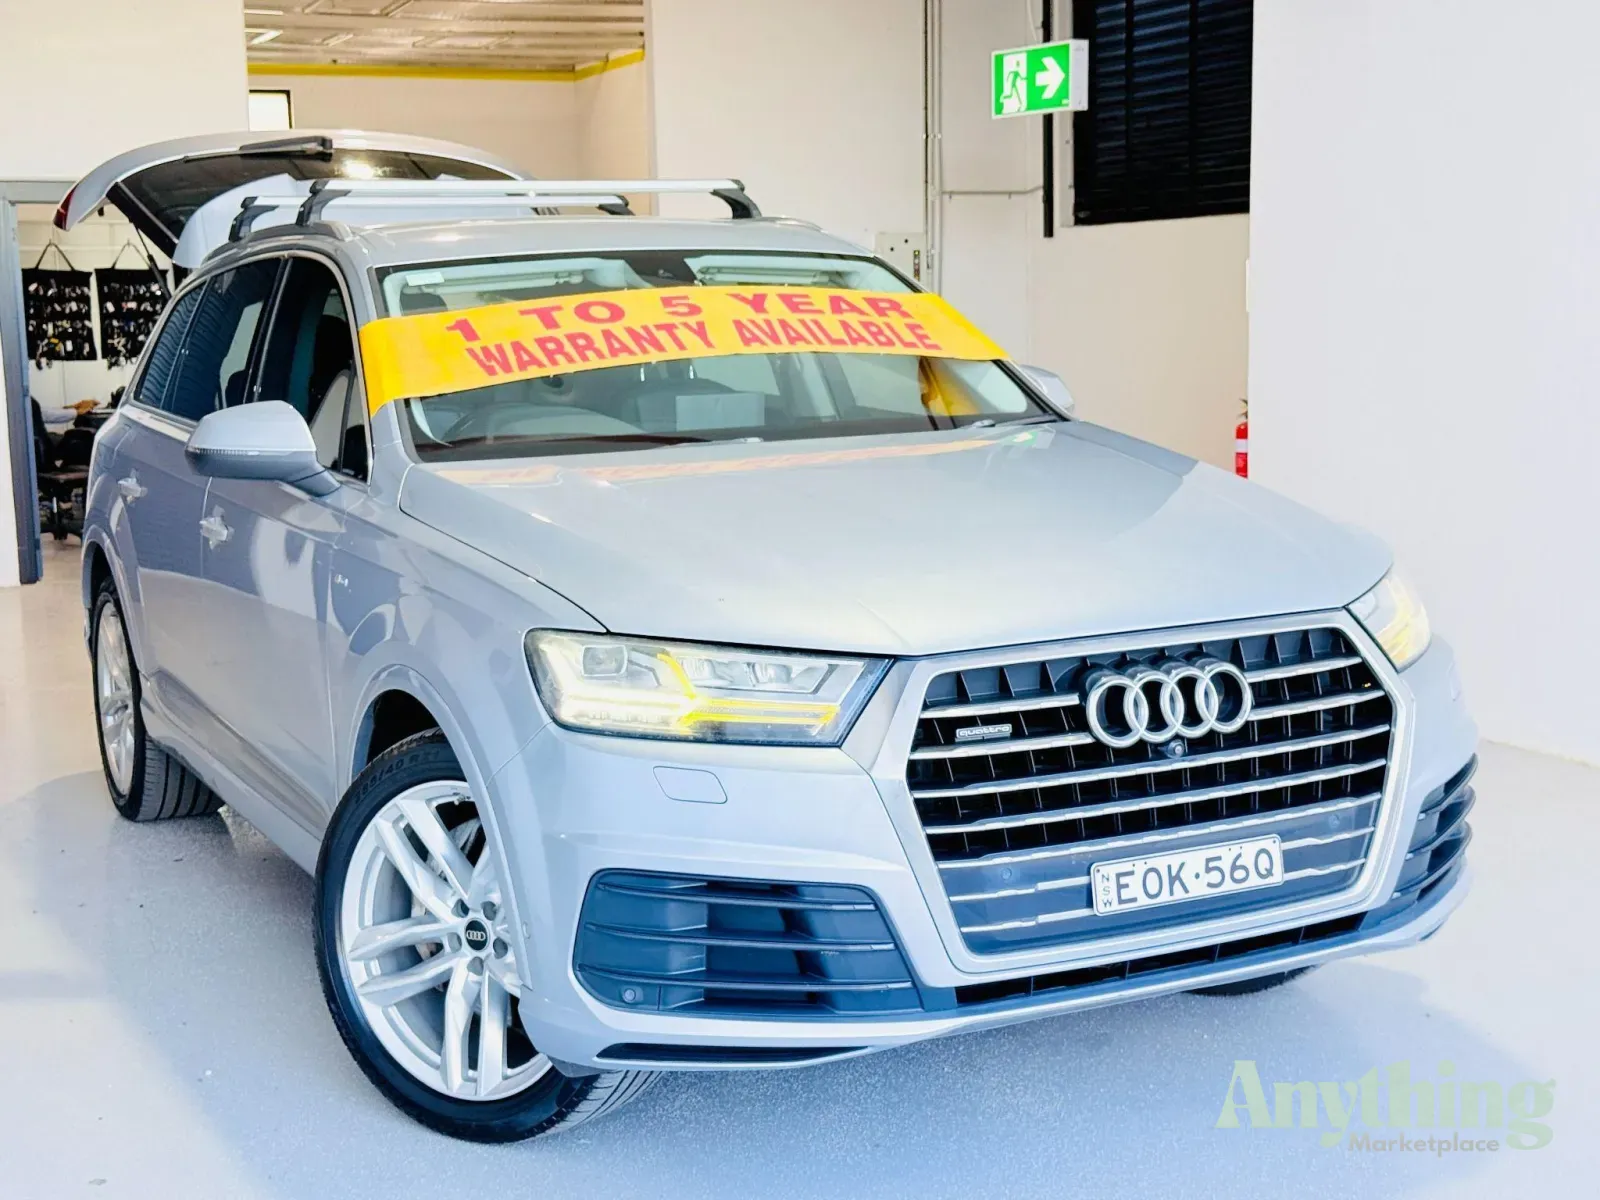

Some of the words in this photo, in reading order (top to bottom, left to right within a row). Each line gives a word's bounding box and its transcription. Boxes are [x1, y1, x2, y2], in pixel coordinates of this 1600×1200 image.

[446, 319, 481, 342] 1
[518, 301, 626, 330] TO
[660, 296, 703, 316] 5
[724, 292, 915, 319] YEAR
[465, 322, 714, 377] WARRANTY
[738, 317, 942, 351] AVAILABLE
[959, 726, 1010, 737] quattro
